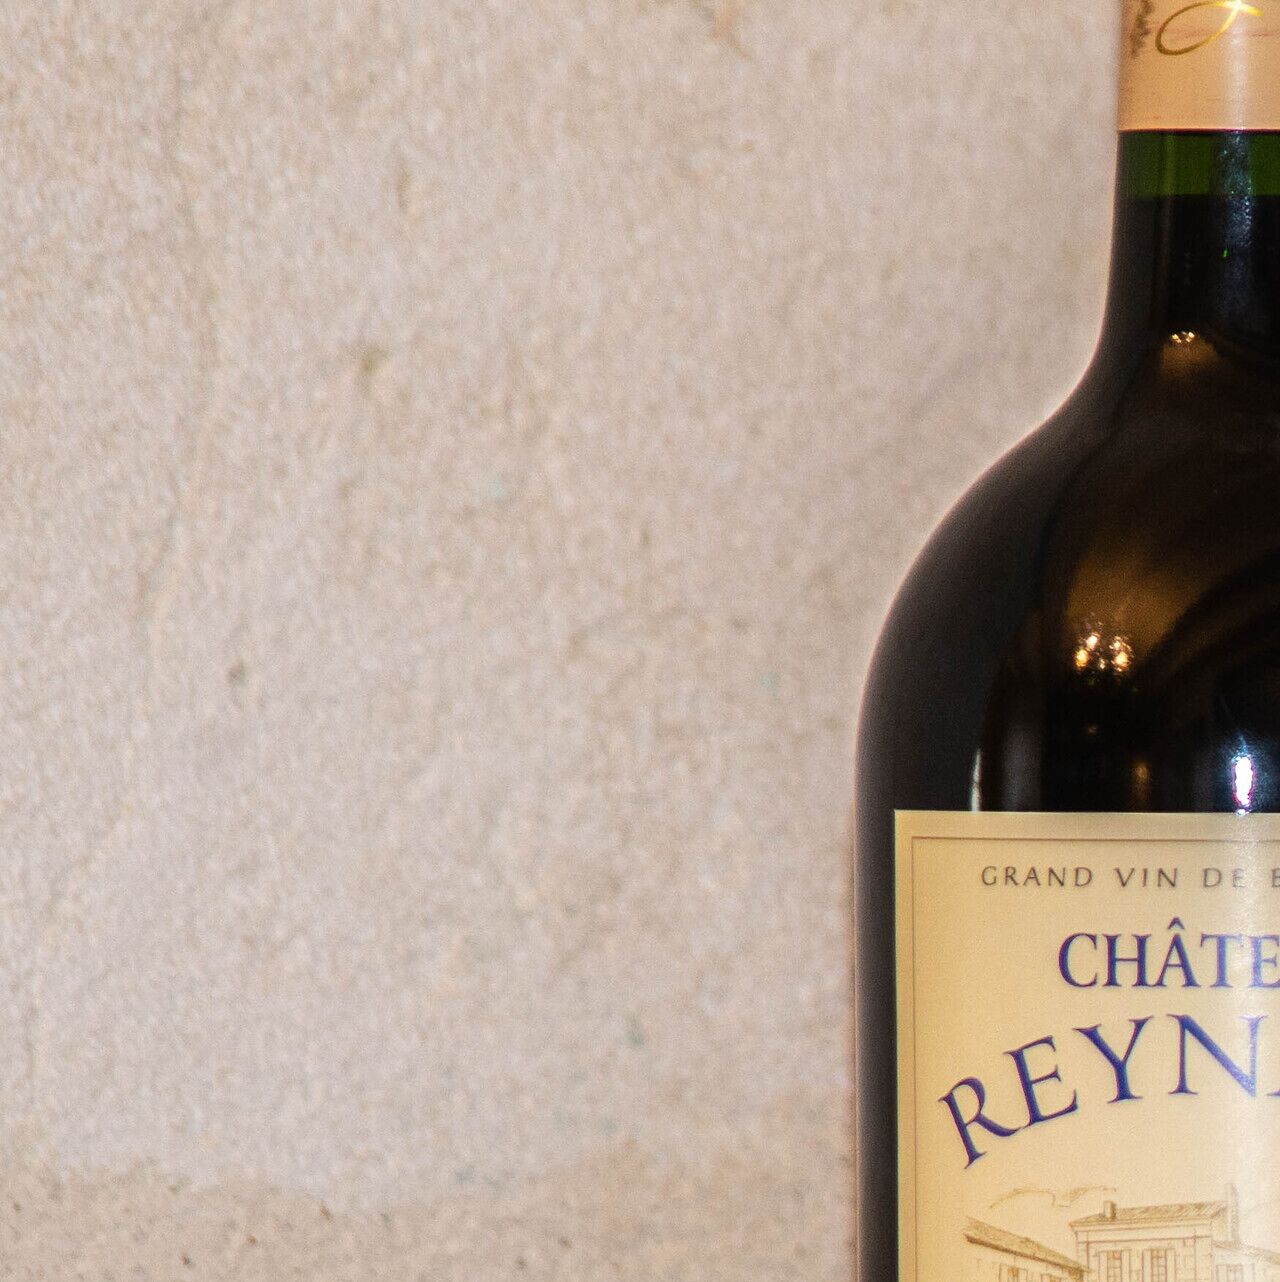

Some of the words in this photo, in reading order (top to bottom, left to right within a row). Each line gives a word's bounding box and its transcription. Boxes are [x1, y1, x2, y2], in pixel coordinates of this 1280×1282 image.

[982, 866, 1093, 887] GRAND
[1114, 866, 1178, 887] VIN
[1201, 867, 1244, 887] DE
